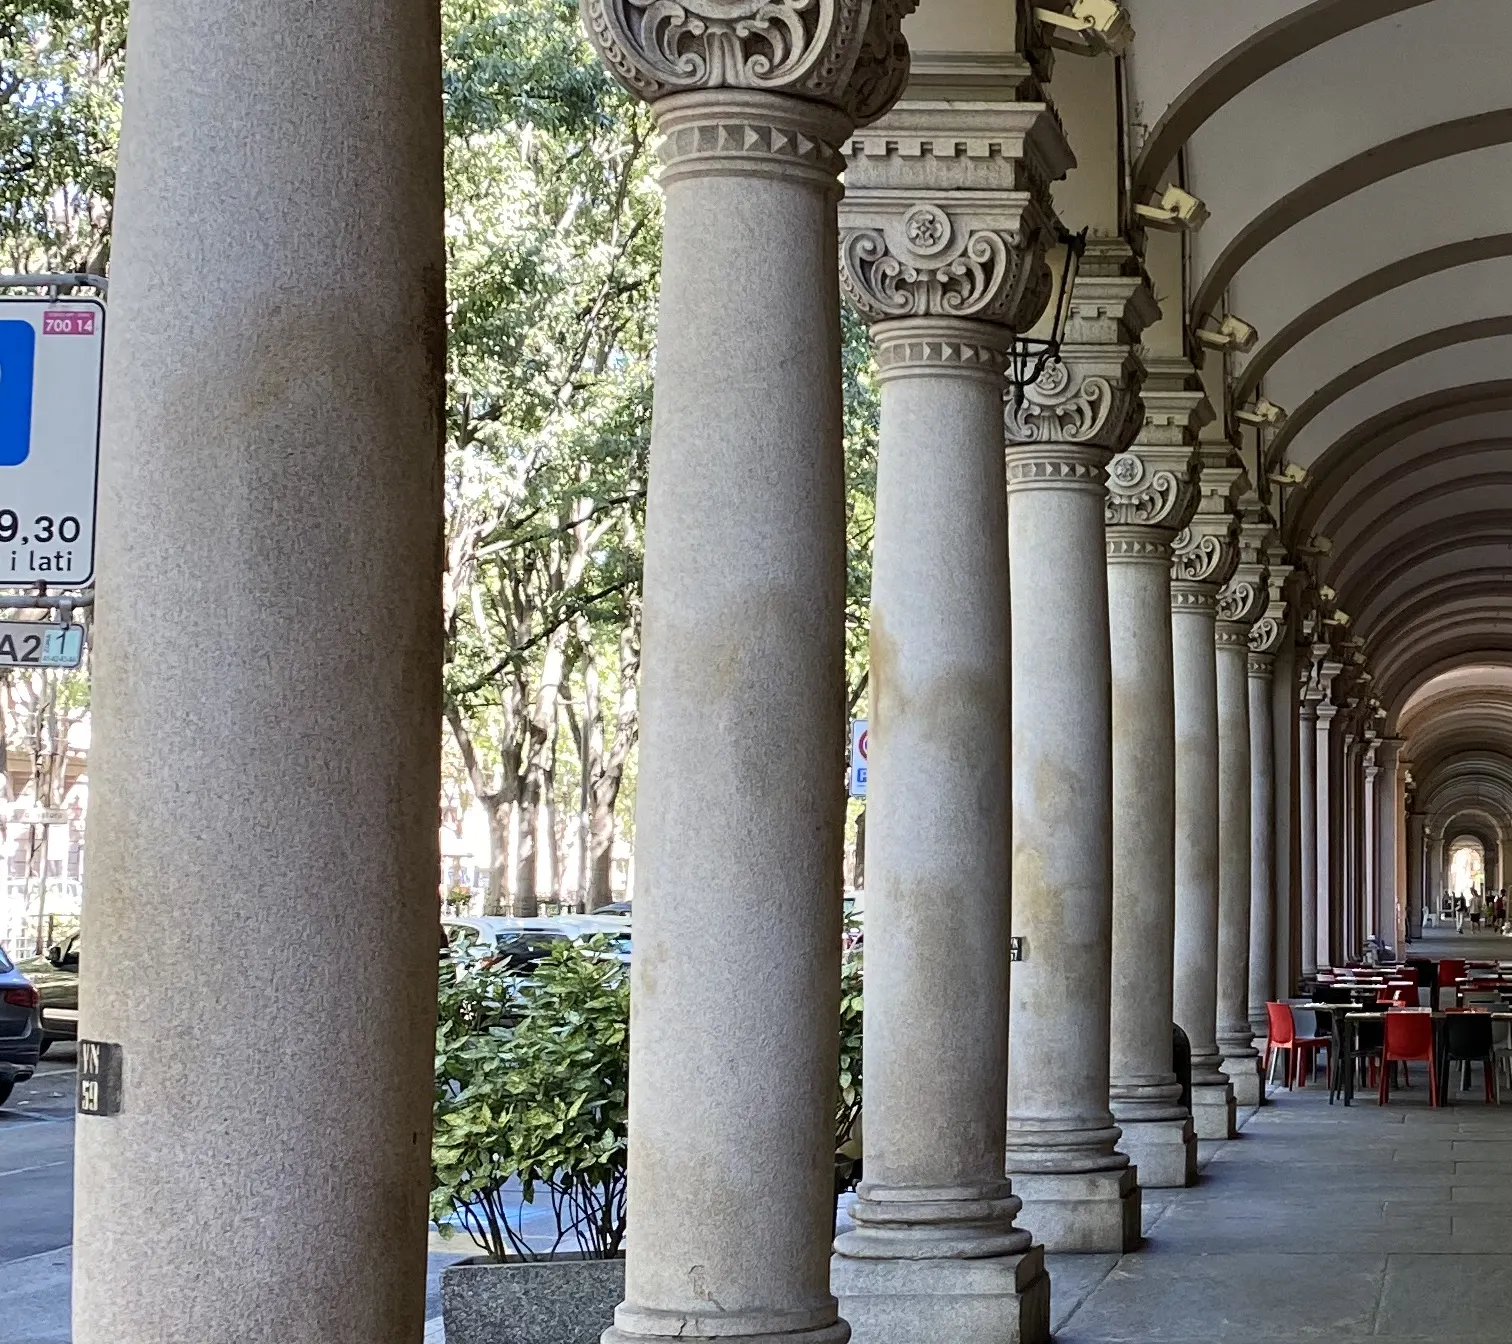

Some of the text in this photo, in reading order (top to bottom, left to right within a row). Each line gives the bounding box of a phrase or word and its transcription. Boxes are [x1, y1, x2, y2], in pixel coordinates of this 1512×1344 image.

[45, 319, 93, 332] 700 14
[29, 550, 73, 572] lati
[81, 1079, 99, 1112] 59
